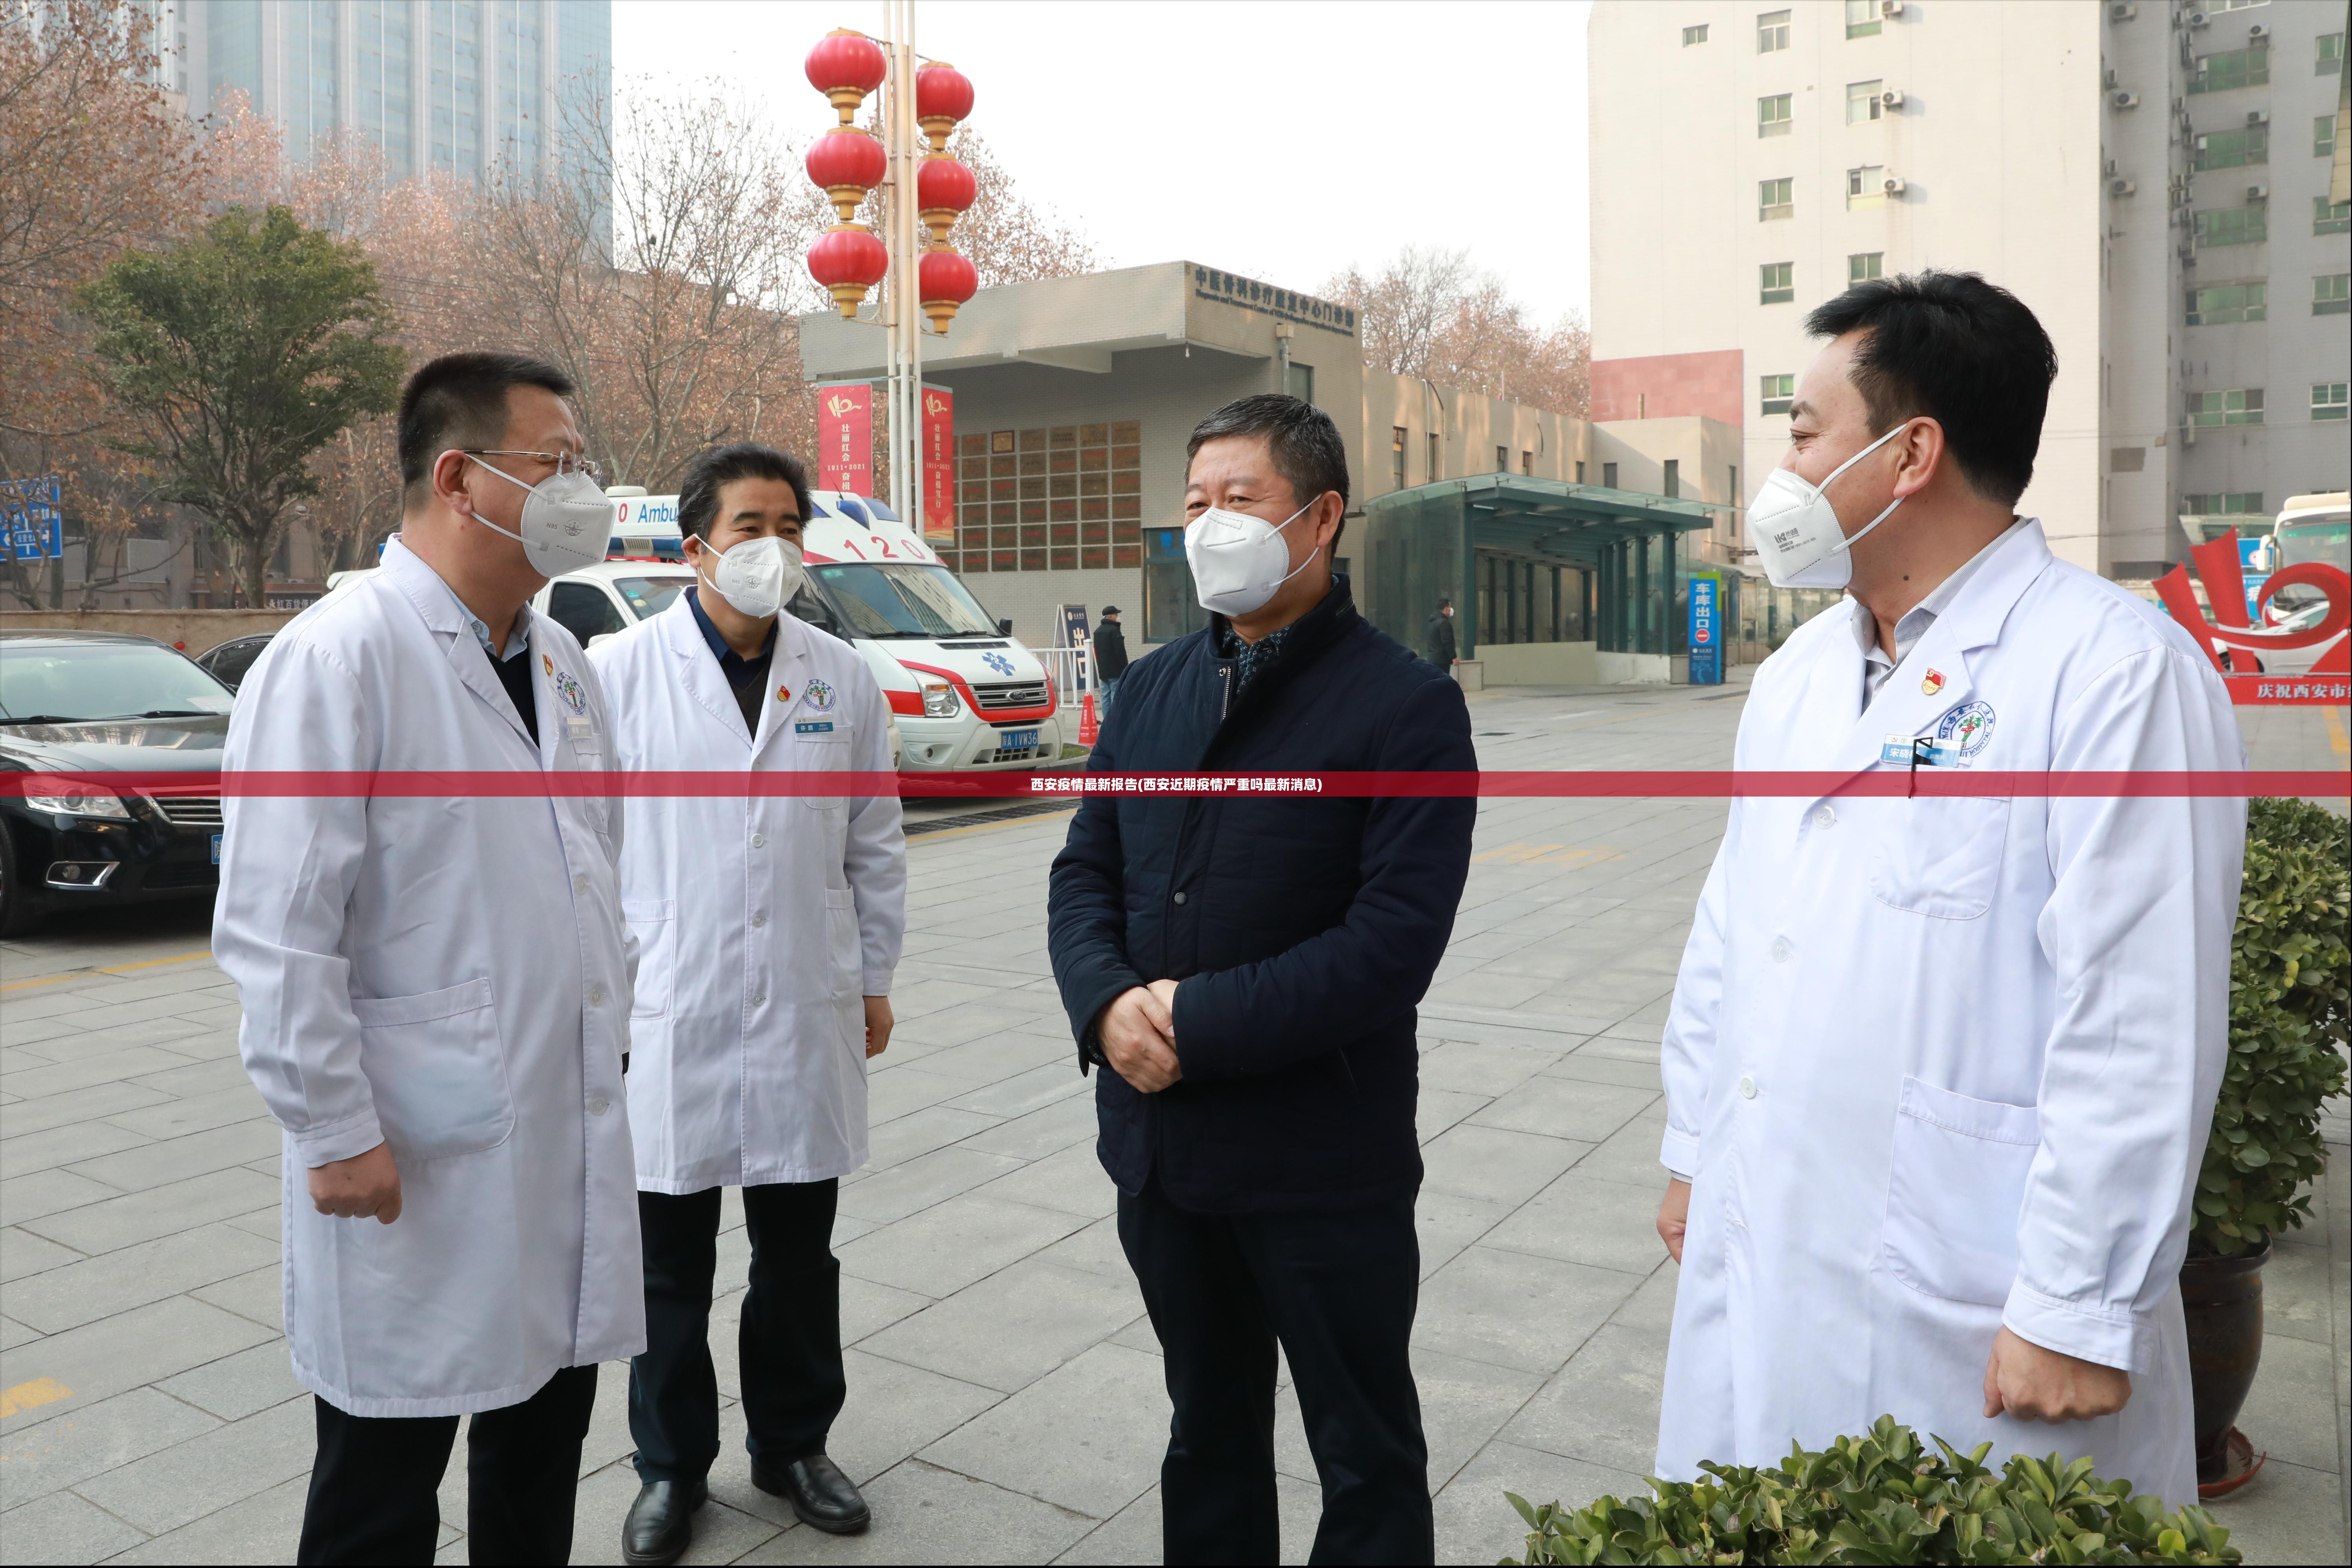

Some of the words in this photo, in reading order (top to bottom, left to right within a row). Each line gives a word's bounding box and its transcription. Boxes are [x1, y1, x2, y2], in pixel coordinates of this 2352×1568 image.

[841, 423, 850, 462] 壮丽红会
[843, 536, 926, 560] 120
[1695, 583, 1710, 628] 车库出口
